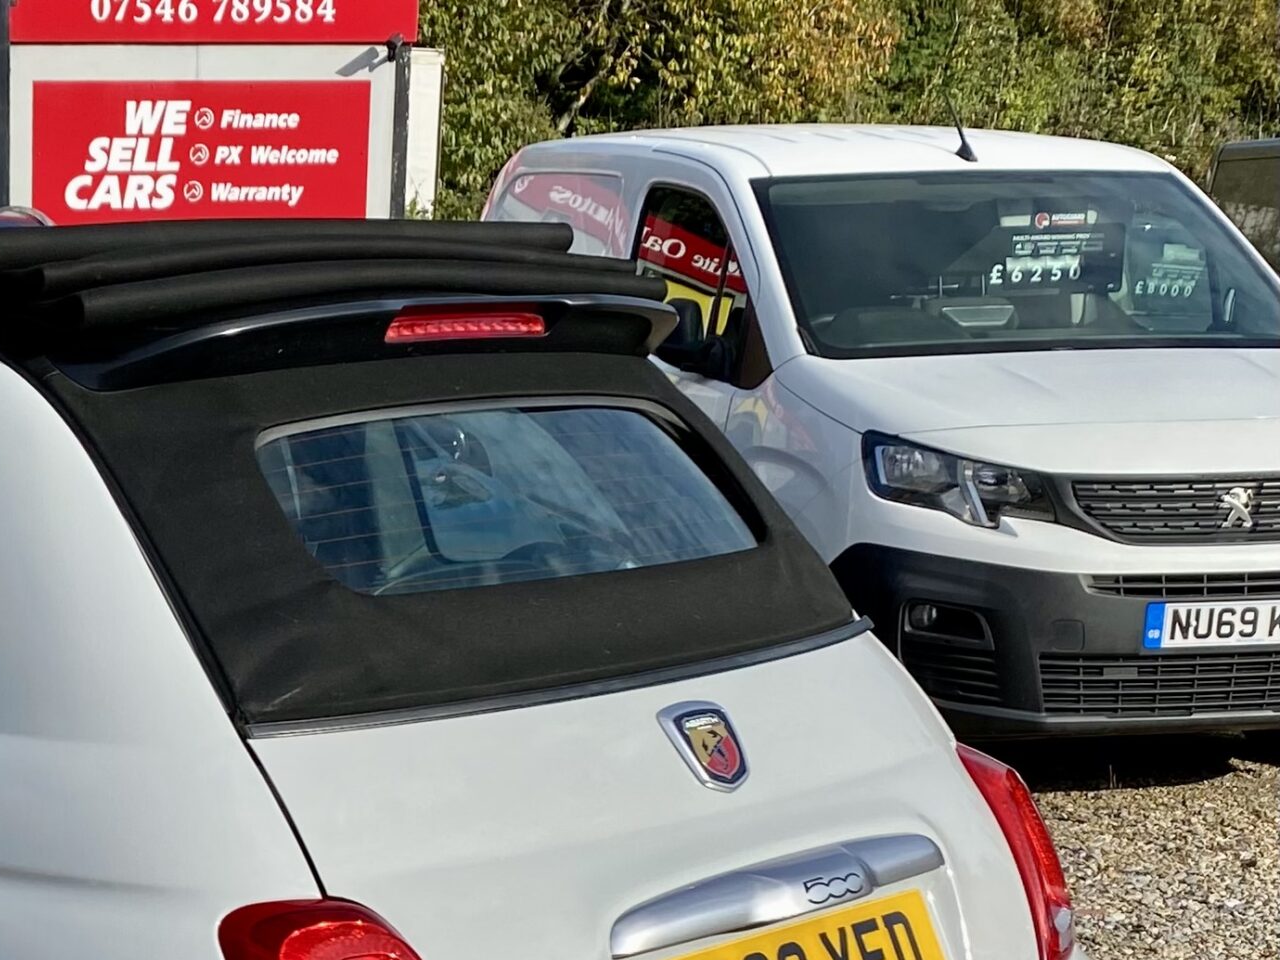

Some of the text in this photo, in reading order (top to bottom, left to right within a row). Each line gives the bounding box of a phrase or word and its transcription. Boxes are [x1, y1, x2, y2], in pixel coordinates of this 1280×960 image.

[90, 0, 336, 22] 07546 789584
[125, 101, 191, 135] WE
[220, 109, 300, 129] Finance
[84, 137, 180, 172] SELL
[214, 145, 339, 165] PX Welcome
[64, 174, 177, 210] CARS
[211, 182, 304, 206] Warranty
[989, 264, 1080, 284] £6250
[1169, 606, 1259, 640] NU69
[803, 872, 864, 904] 500
